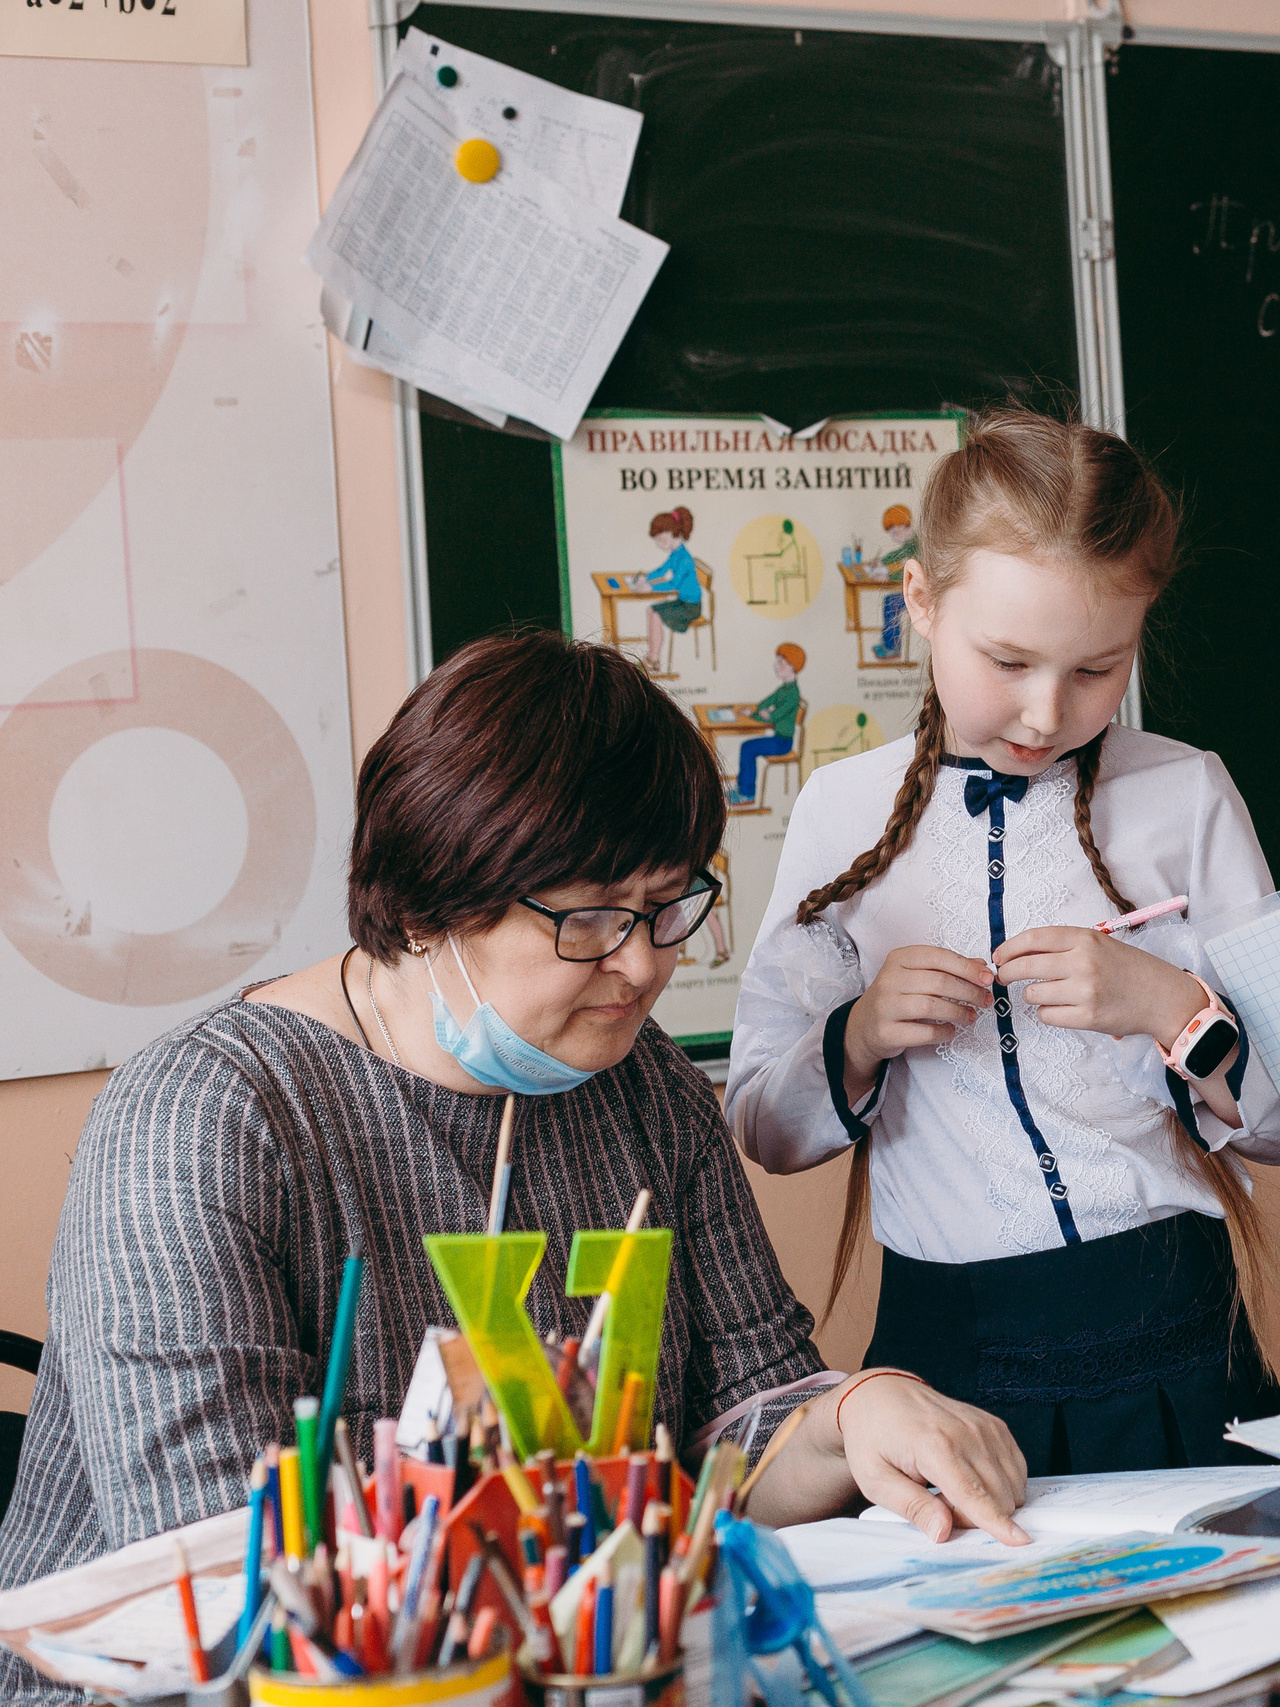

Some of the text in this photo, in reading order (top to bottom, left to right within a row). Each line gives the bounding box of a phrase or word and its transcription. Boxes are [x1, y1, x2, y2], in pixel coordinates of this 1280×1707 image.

[586, 428, 938, 455] ПРАВИЛЬНАЯ ПОСАДКА
[619, 462, 913, 491] ВО ВРЕМЯ ЗАНЯТИЙ
